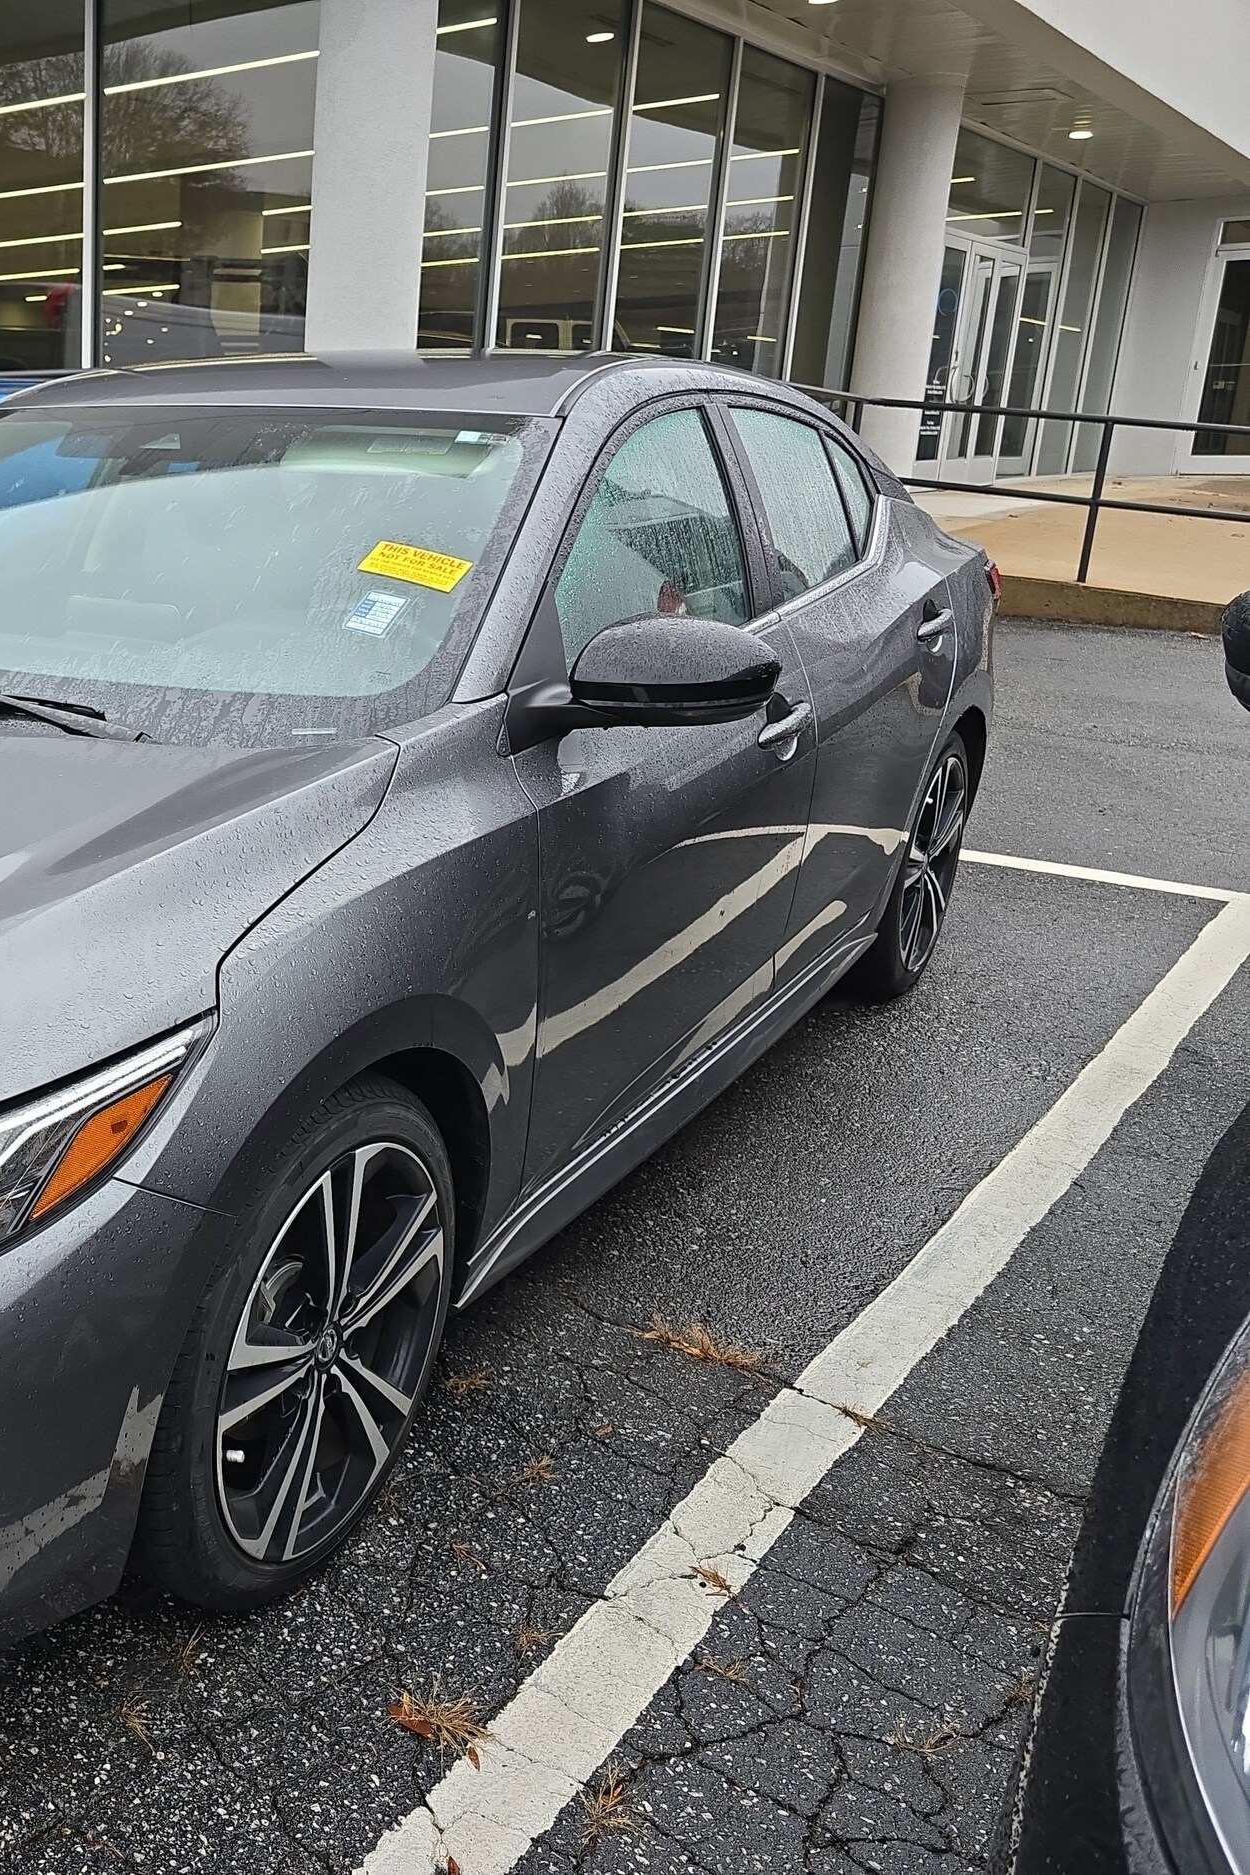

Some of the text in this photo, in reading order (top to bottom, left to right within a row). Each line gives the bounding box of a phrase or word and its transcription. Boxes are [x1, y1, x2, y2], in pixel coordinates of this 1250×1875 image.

[378, 552, 399, 560] NOT
[402, 557, 425, 567] FOR
[428, 563, 457, 575] SALE
[382, 543, 466, 570] THIS VEHICLE
